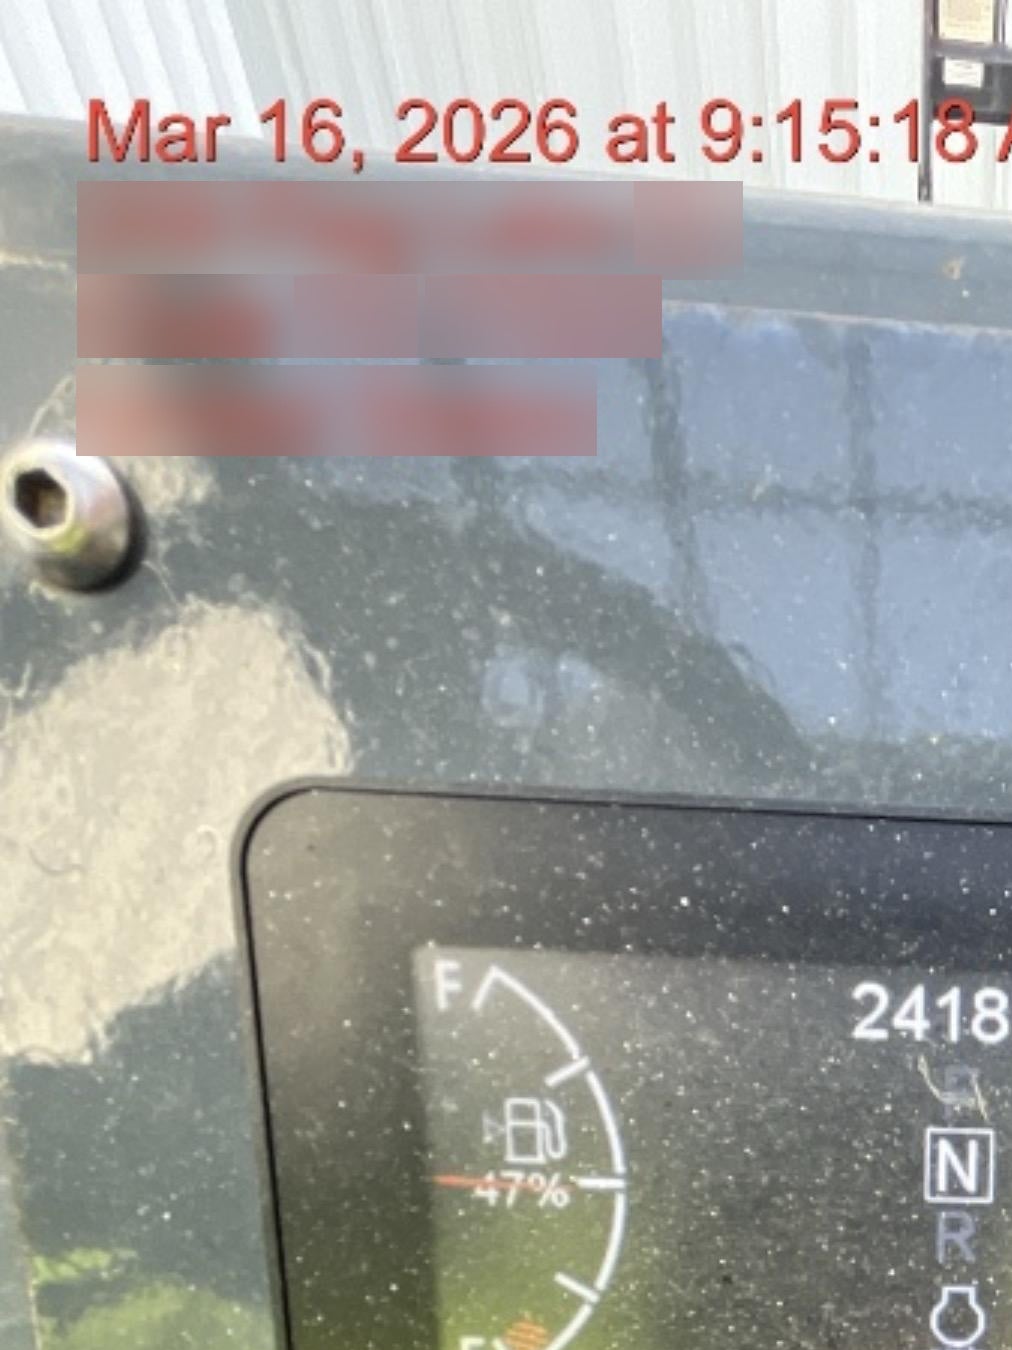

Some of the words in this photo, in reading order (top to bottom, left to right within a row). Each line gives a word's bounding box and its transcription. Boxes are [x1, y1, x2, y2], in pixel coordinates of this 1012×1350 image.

[434, 961, 463, 1011] F
[471, 1169, 572, 1209] 47%
[937, 1137, 978, 1193] N
[935, 1211, 976, 1265] R
